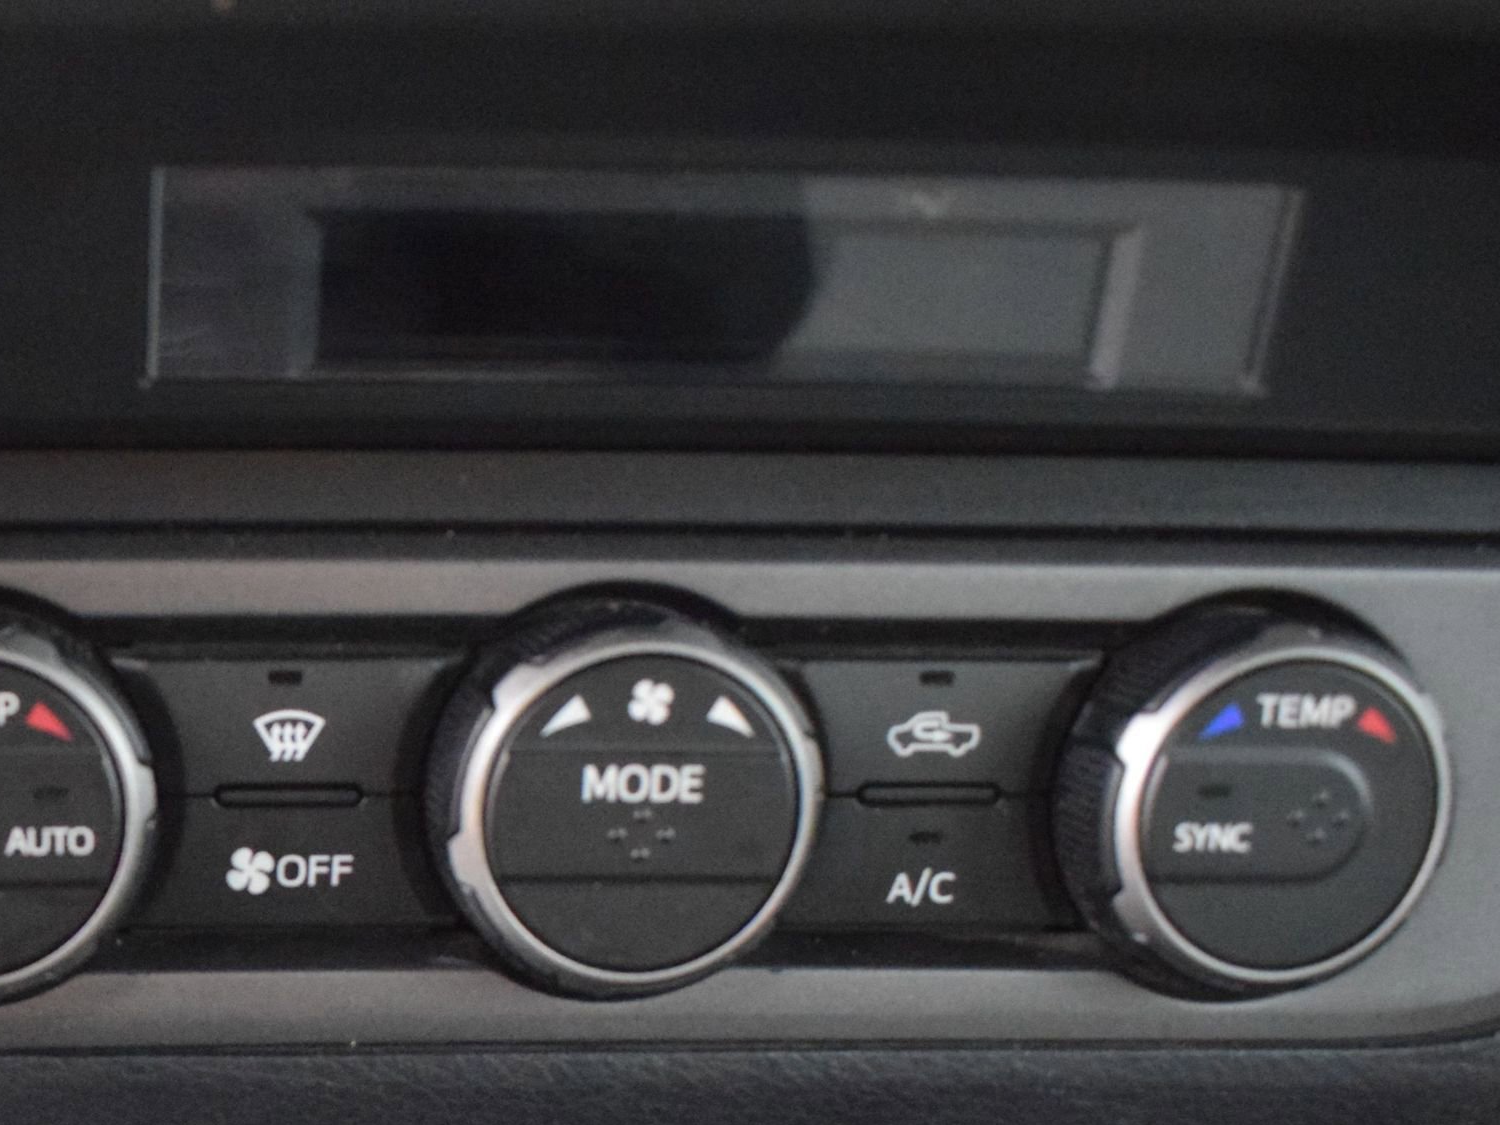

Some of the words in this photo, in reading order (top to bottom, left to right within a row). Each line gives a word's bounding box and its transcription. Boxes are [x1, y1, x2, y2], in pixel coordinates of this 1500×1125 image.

[1256, 694, 1357, 728] TEMP
[581, 765, 706, 803] MODE
[4, 825, 95, 858] AUTO
[1172, 822, 1253, 856] SYNC
[275, 854, 355, 888] OFF
[886, 870, 956, 906] A/C
